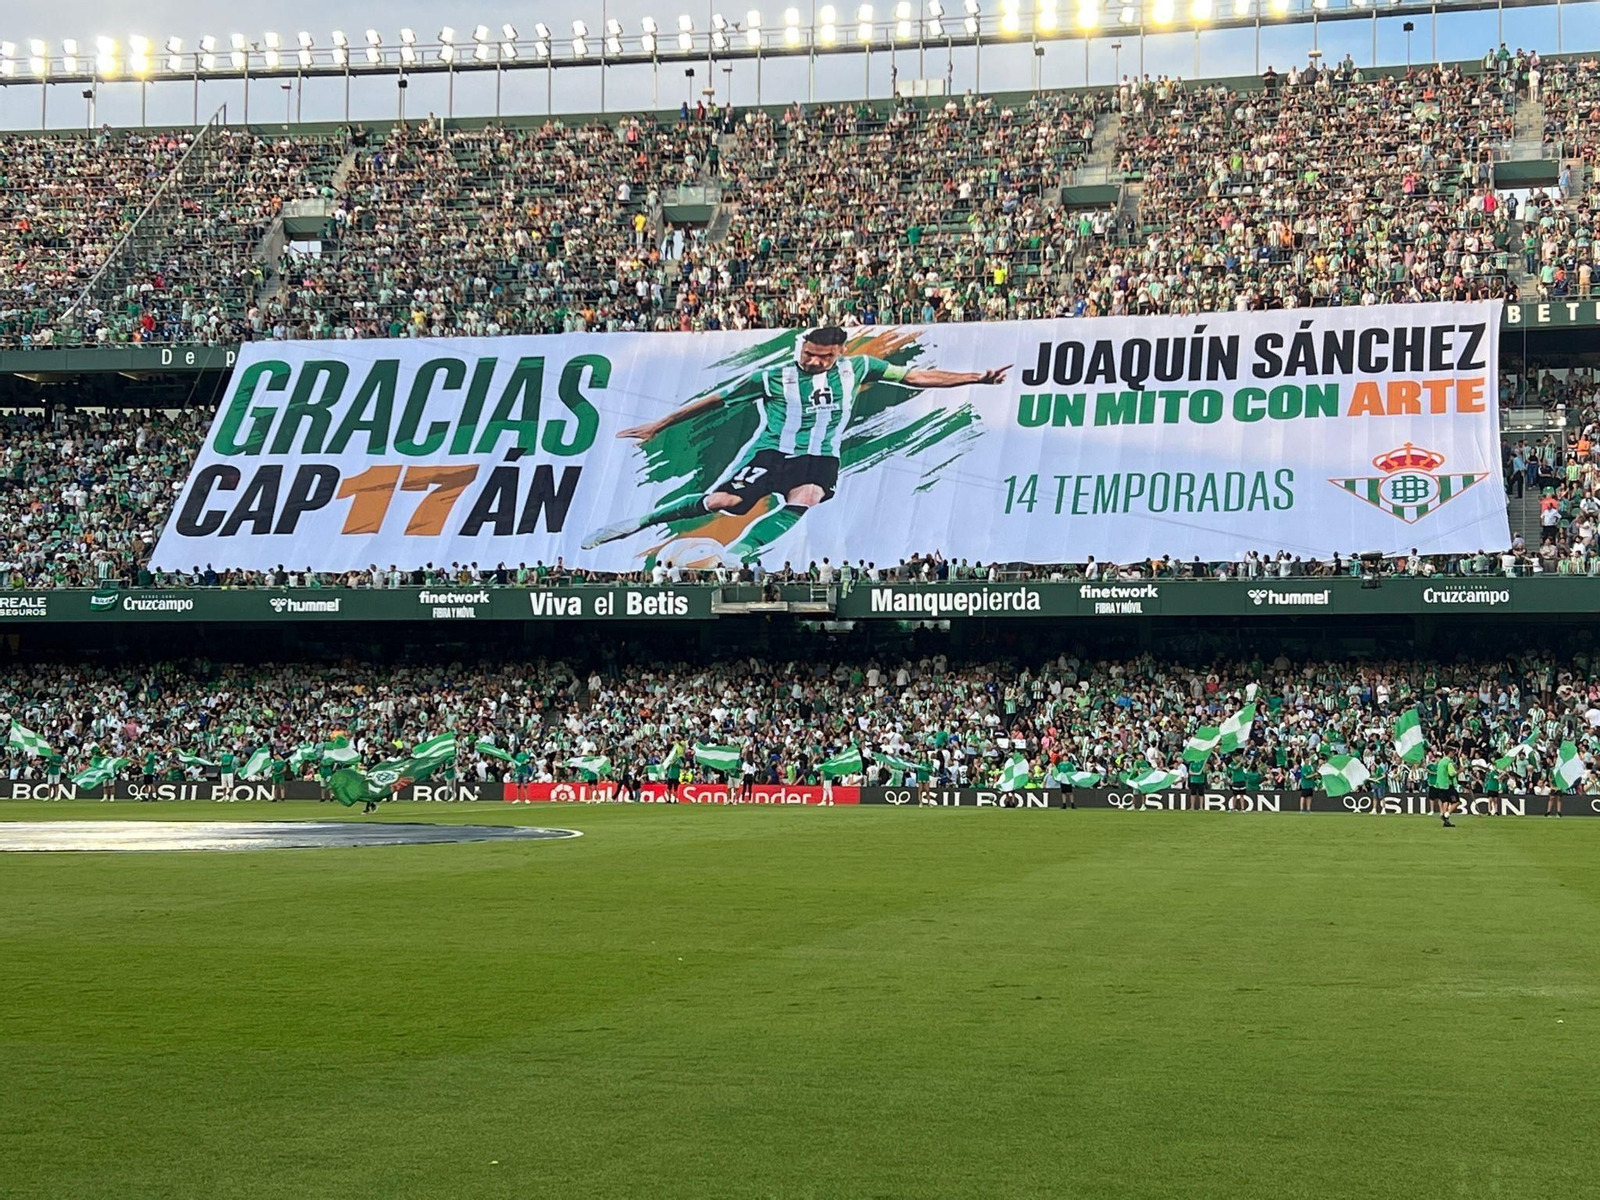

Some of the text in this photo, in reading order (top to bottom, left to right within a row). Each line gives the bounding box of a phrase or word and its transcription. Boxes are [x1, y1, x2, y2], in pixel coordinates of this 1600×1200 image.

[162, 349, 195, 364] De
[1021, 319, 1487, 391] JOAQUÍN SÁNCHEZ
[213, 353, 613, 457] GRACIAS
[1017, 377, 1486, 427] UN MITO CON ARTE
[734, 466, 768, 484] 17
[175, 447, 583, 538] CAP17ÁN
[1003, 468, 1294, 515] 14 TEMPORADAS
[419, 591, 490, 604] finetwork
[1080, 584, 1158, 598] finetwork
[1268, 589, 1329, 604] hummel
[1423, 587, 1510, 605] Cruzcampo
[0, 597, 47, 608] REALE
[123, 597, 194, 612] Cruzcampo
[287, 598, 339, 612] hummel
[529, 591, 689, 616] Viva el Betis
[870, 587, 1041, 616] Manquepierda
[0, 783, 77, 800] BON
